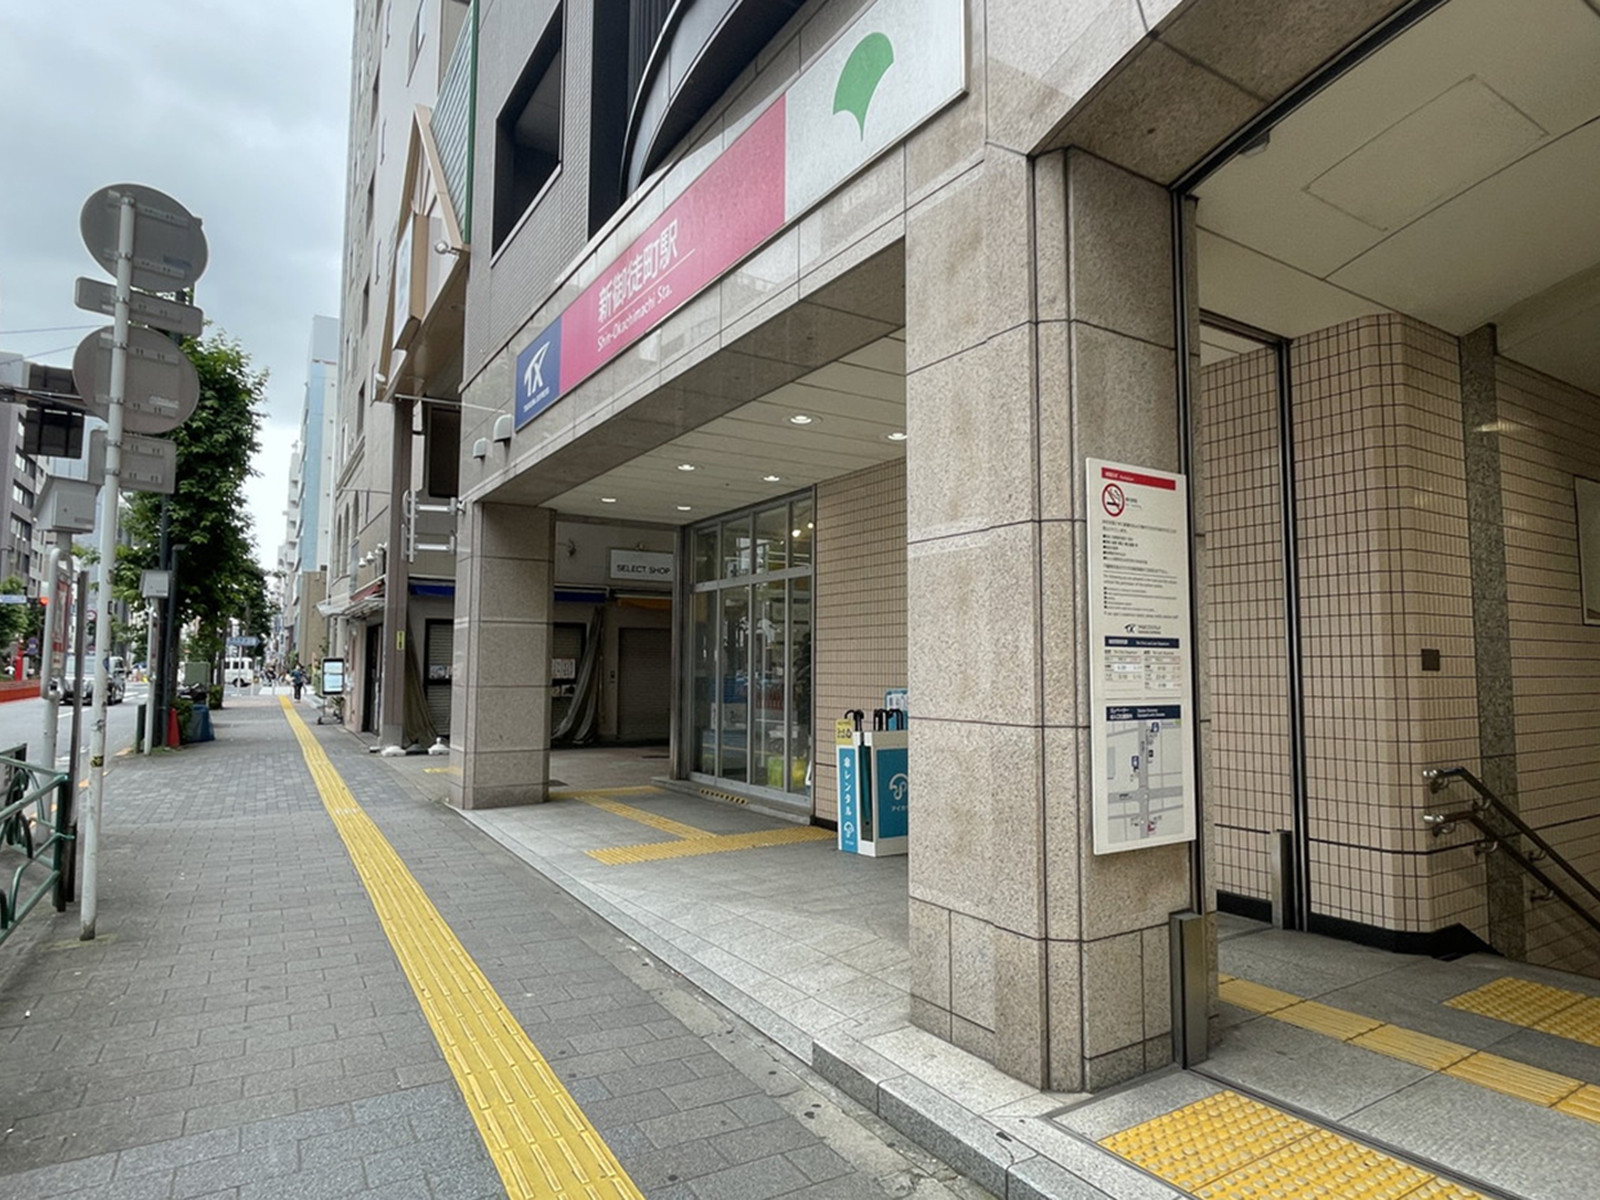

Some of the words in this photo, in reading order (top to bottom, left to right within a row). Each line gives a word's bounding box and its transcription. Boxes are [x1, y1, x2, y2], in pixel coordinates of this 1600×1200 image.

[598, 219, 678, 323] 新御徒町駅
[597, 292, 656, 352] Shin-Okachimachi
[657, 284, 673, 304] Sta.
[616, 564, 647, 574] SELECT
[649, 566, 671, 575] SHOP
[843, 756, 852, 816] 傘レンタル
